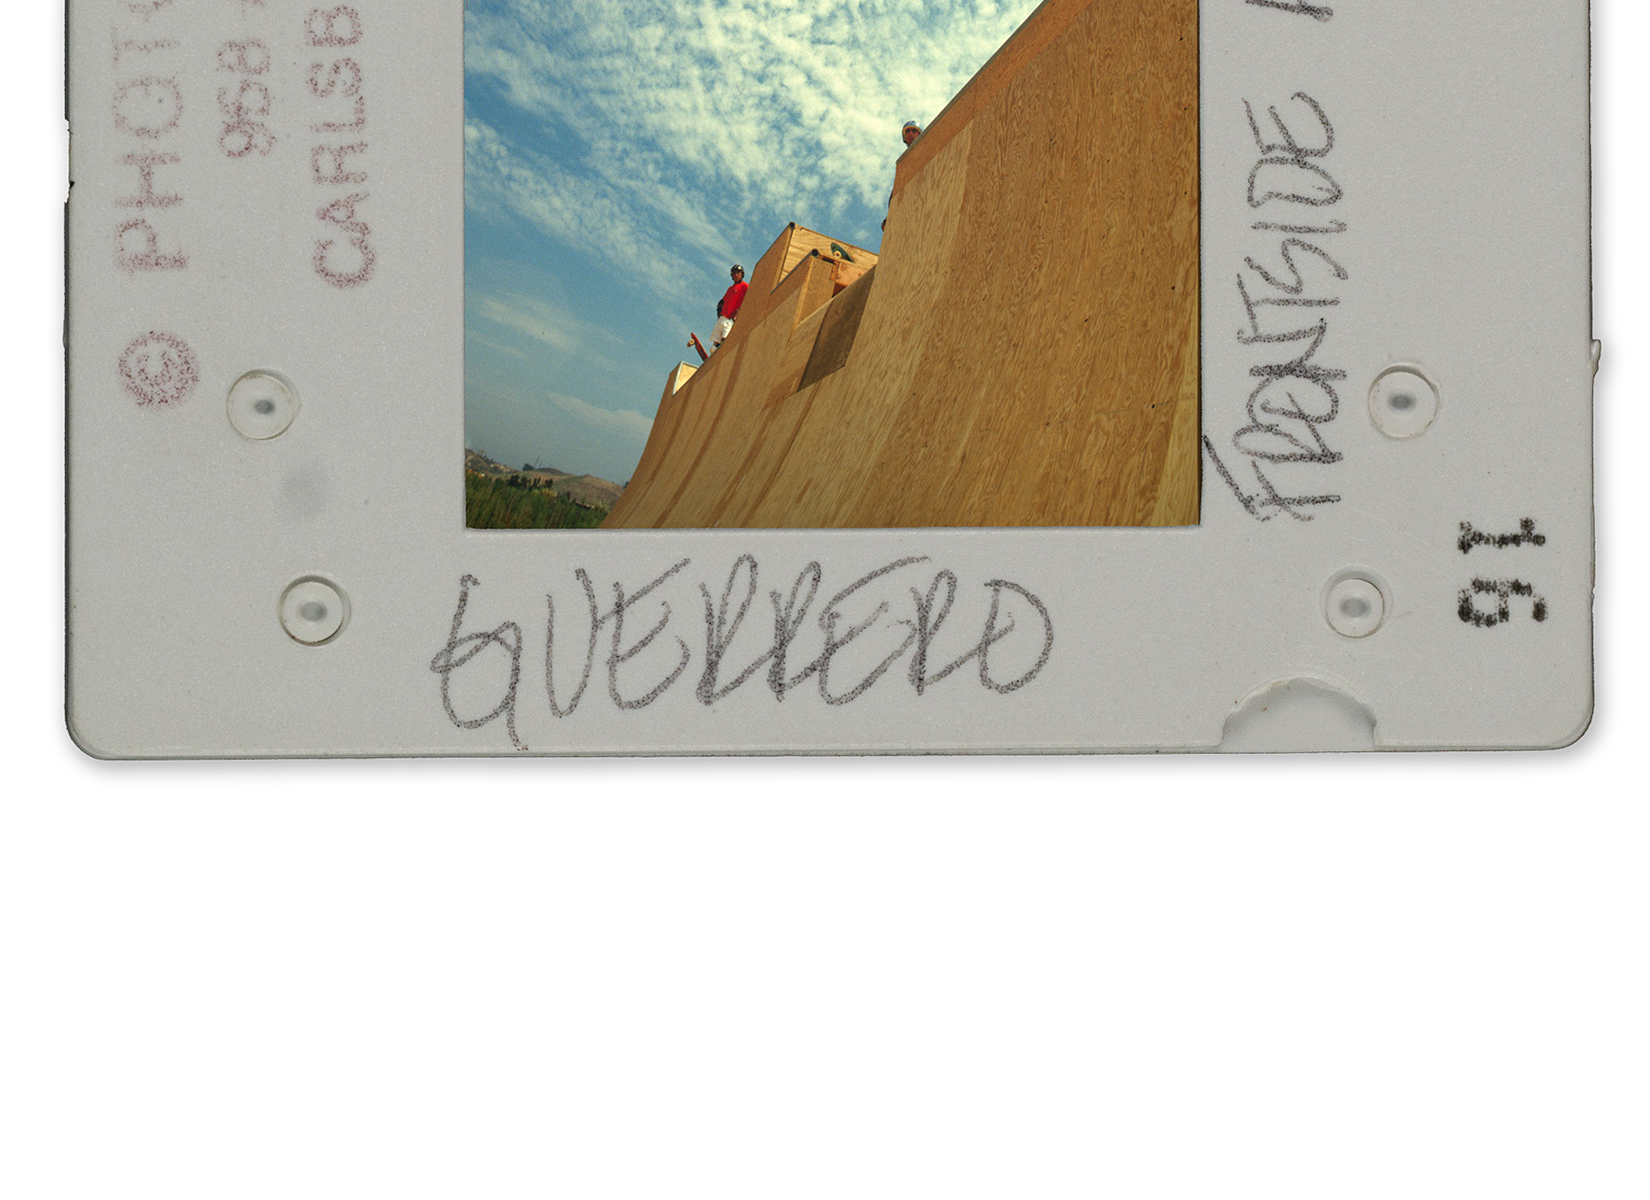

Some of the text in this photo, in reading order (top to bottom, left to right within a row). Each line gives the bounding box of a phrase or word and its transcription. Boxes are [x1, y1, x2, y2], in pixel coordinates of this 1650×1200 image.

[1203, 91, 1347, 522] FRONTSIDE
[430, 553, 1055, 750] GUERRERO
[1458, 519, 1546, 628] 16
